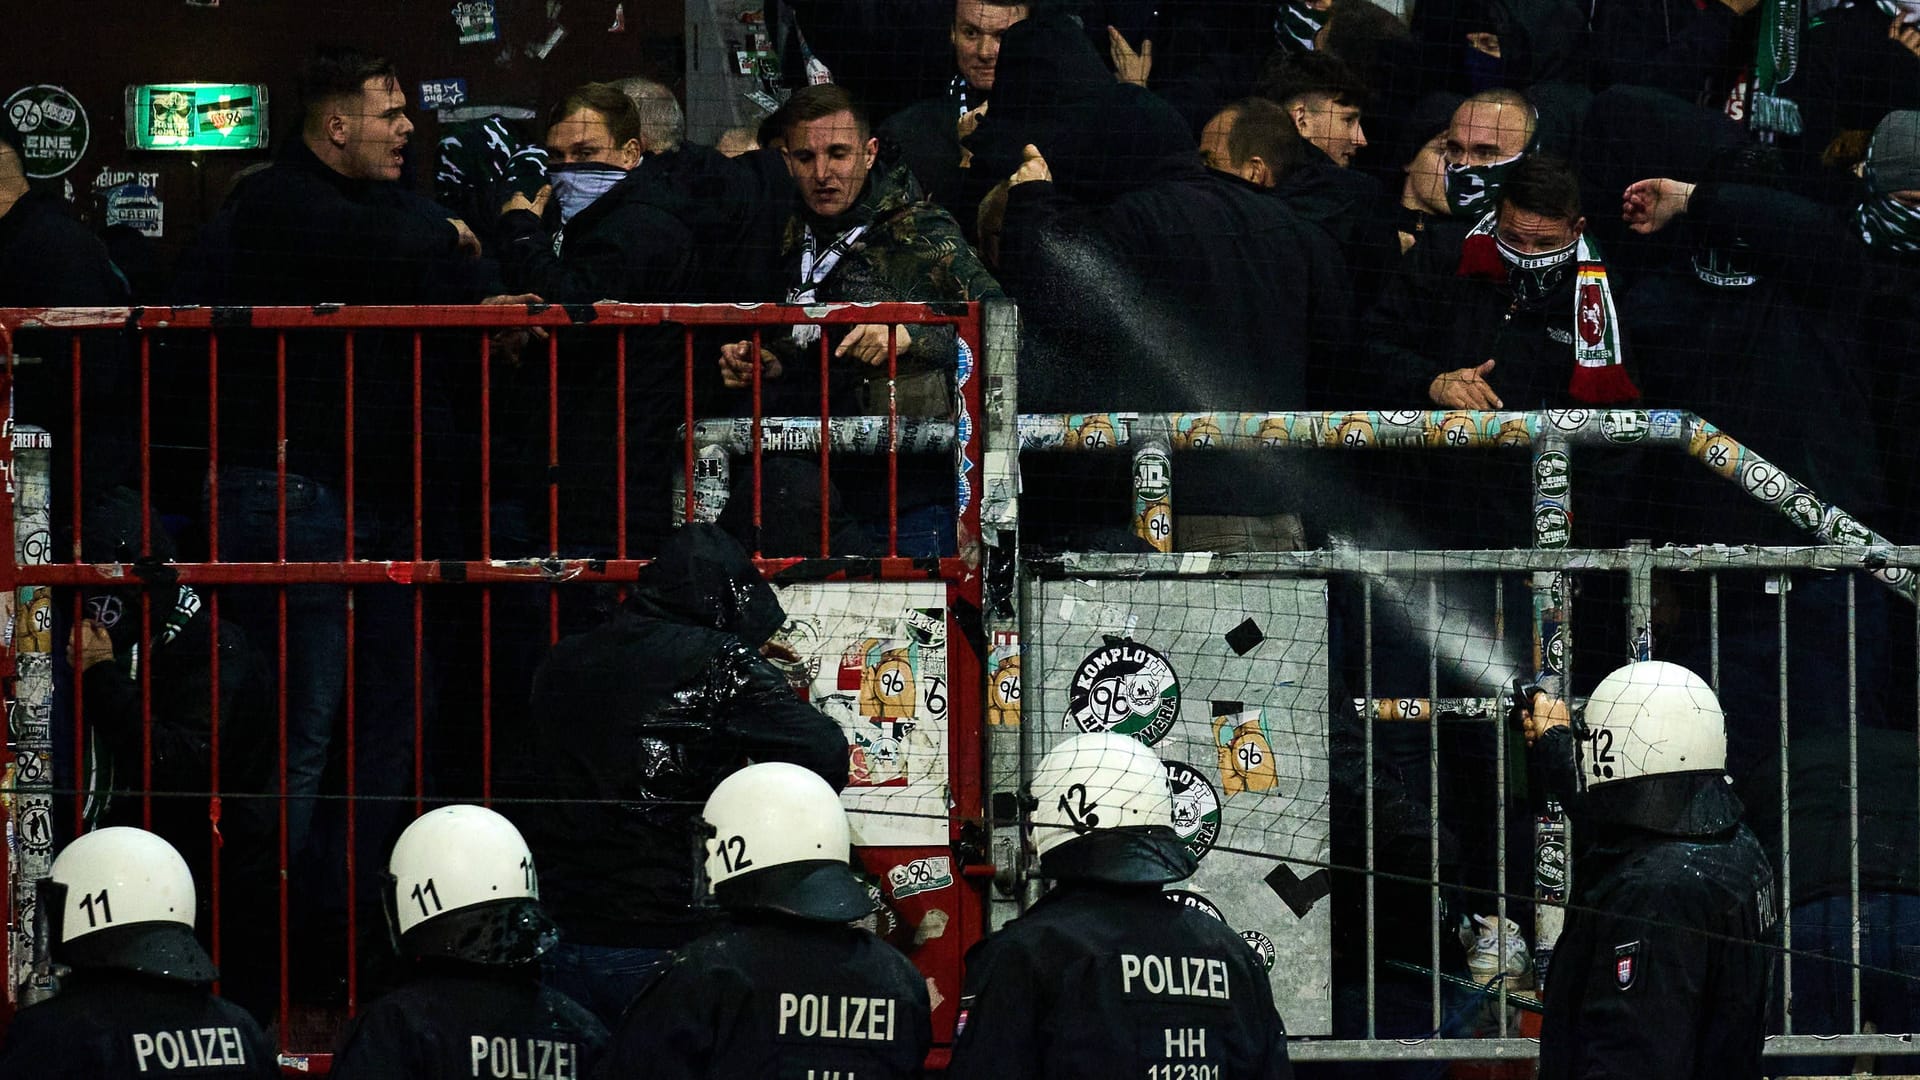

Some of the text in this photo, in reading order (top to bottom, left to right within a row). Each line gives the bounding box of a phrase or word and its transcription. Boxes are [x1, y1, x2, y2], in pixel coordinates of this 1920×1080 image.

[10, 102, 40, 131] 96
[226, 111, 241, 125] 96
[25, 135, 72, 149] EINE
[25, 151, 77, 159] LLEKTIV
[12, 432, 52, 448] EREIT FÜ
[1447, 425, 1469, 447] 96
[1709, 445, 1728, 466] 96
[1749, 465, 1780, 498] 96
[1150, 513, 1170, 540] 96
[35, 607, 51, 632] 96
[882, 669, 904, 697] 96
[1077, 647, 1168, 690] KOMPLOTT
[1000, 676, 1021, 704] 96
[1094, 678, 1131, 725] 96
[1399, 699, 1421, 719] 96
[1239, 742, 1262, 771] 96
[1588, 729, 1615, 763] 12
[17, 752, 39, 778] 96
[1058, 783, 1098, 834] 12
[716, 835, 753, 873] 12
[910, 860, 930, 883] 96
[79, 889, 113, 927] 11
[411, 878, 442, 916] 11
[1120, 954, 1230, 1000] POLIZEI
[779, 992, 896, 1040] POLIZEI
[132, 1026, 246, 1072] POLIZEI
[470, 1035, 577, 1080] POLIZEI
[1164, 1028, 1206, 1058] HH
